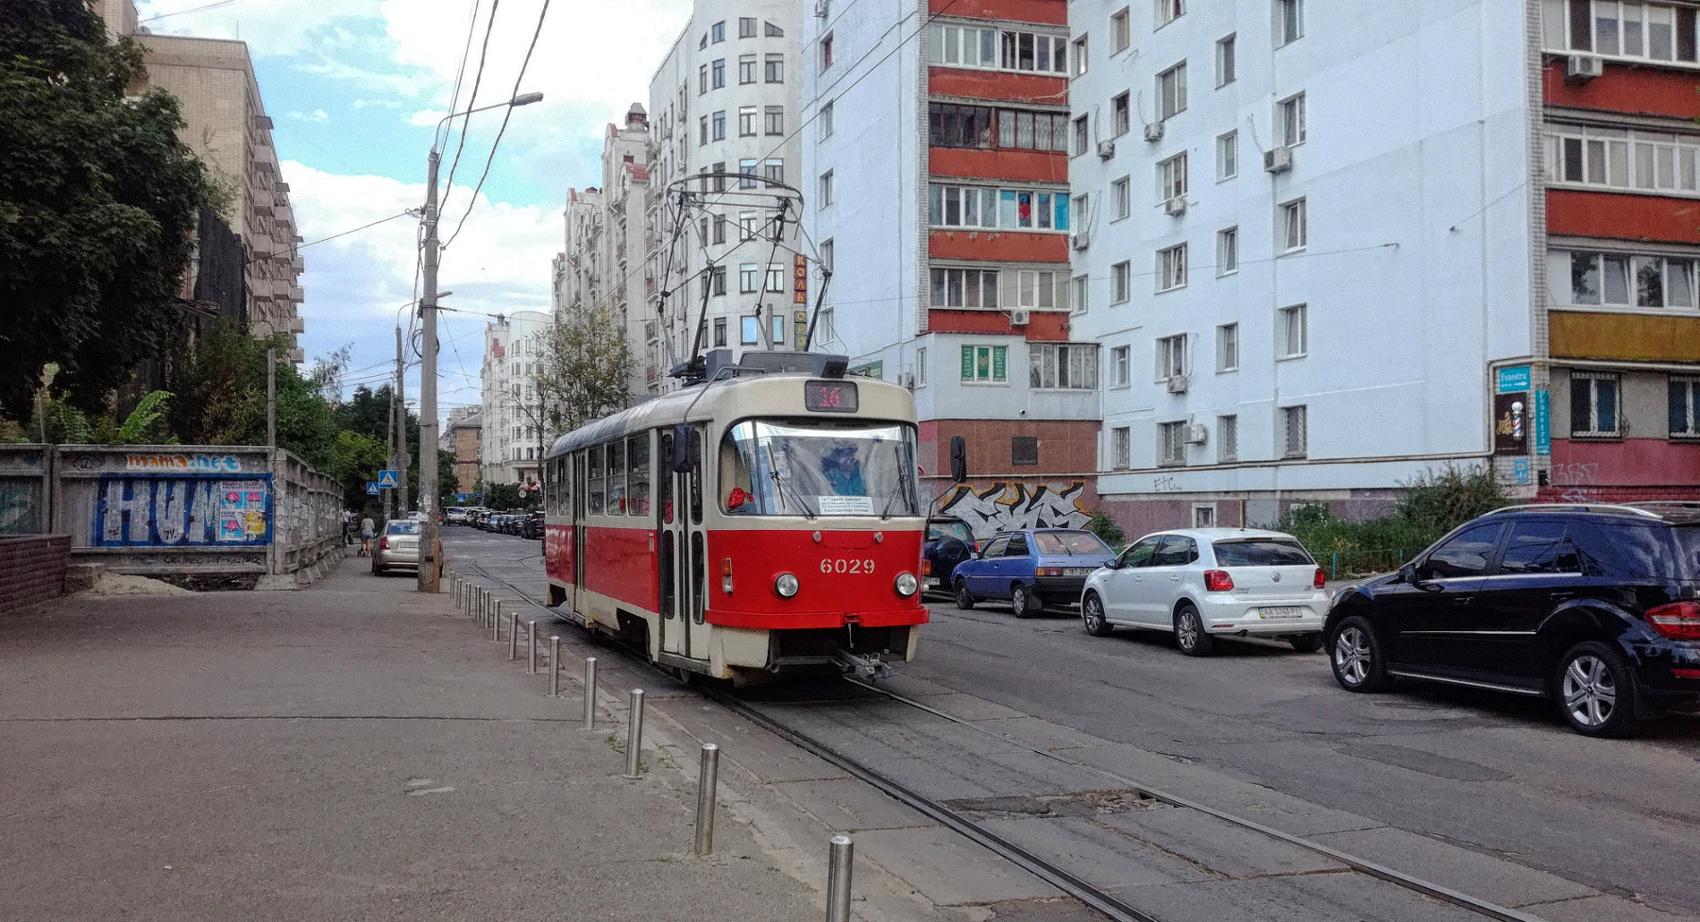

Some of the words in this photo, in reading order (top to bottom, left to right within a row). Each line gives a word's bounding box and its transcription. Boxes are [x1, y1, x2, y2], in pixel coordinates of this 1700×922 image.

[1500, 372, 1527, 382] Fenestra
[820, 386, 841, 407] 16
[1539, 391, 1547, 445] Fenestra
[820, 558, 876, 574] 6029
